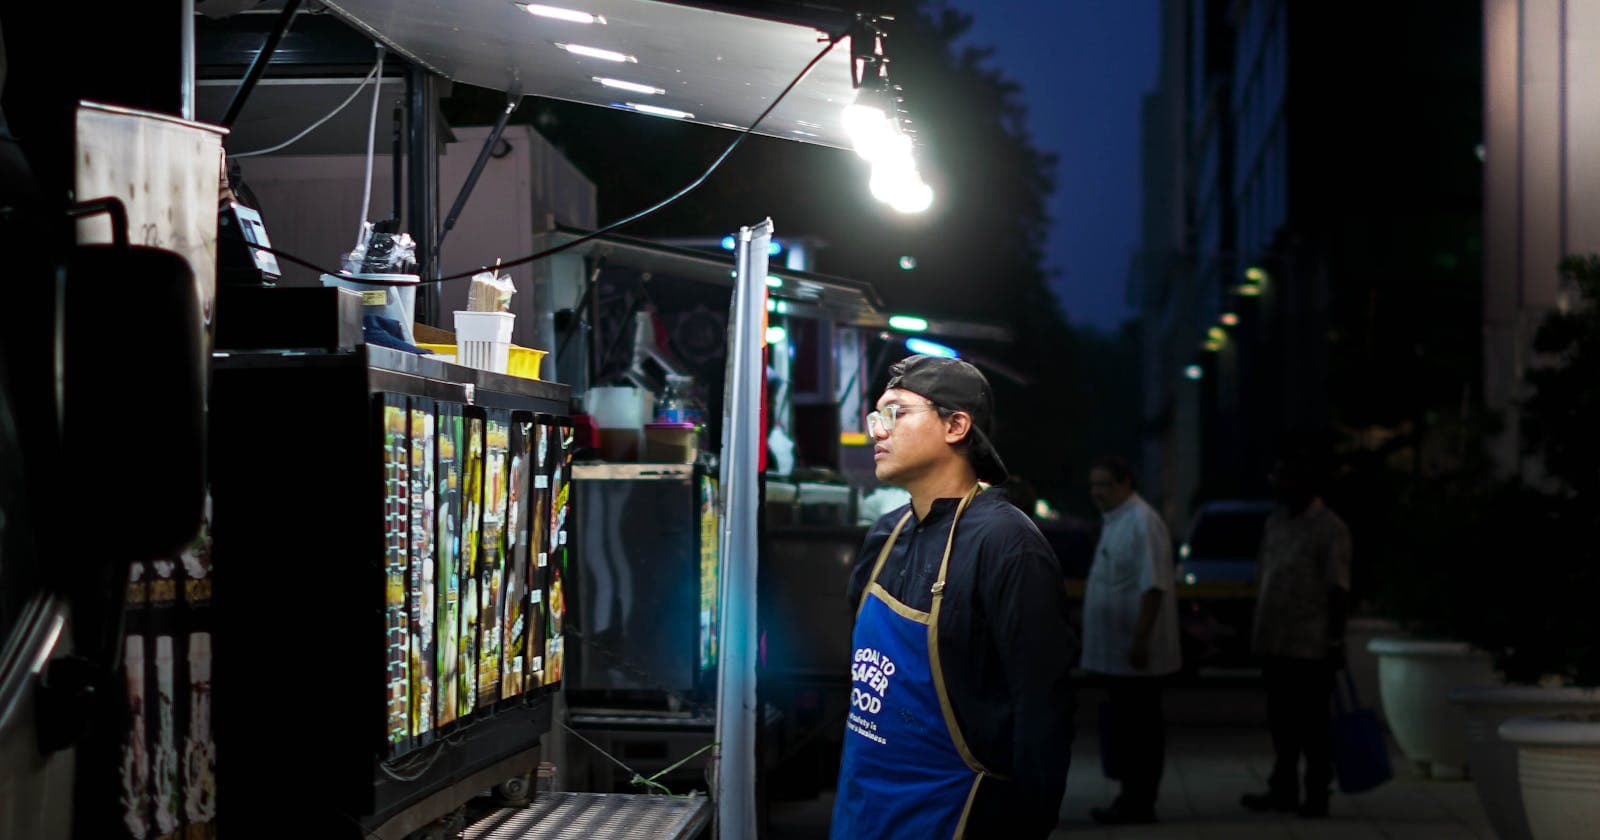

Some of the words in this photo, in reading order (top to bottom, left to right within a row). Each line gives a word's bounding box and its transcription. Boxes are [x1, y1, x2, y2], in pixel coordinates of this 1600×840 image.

[854, 648, 880, 666] GOAL
[880, 655, 896, 676] TO
[851, 663, 889, 697] SAFER
[850, 687, 881, 714] OOD
